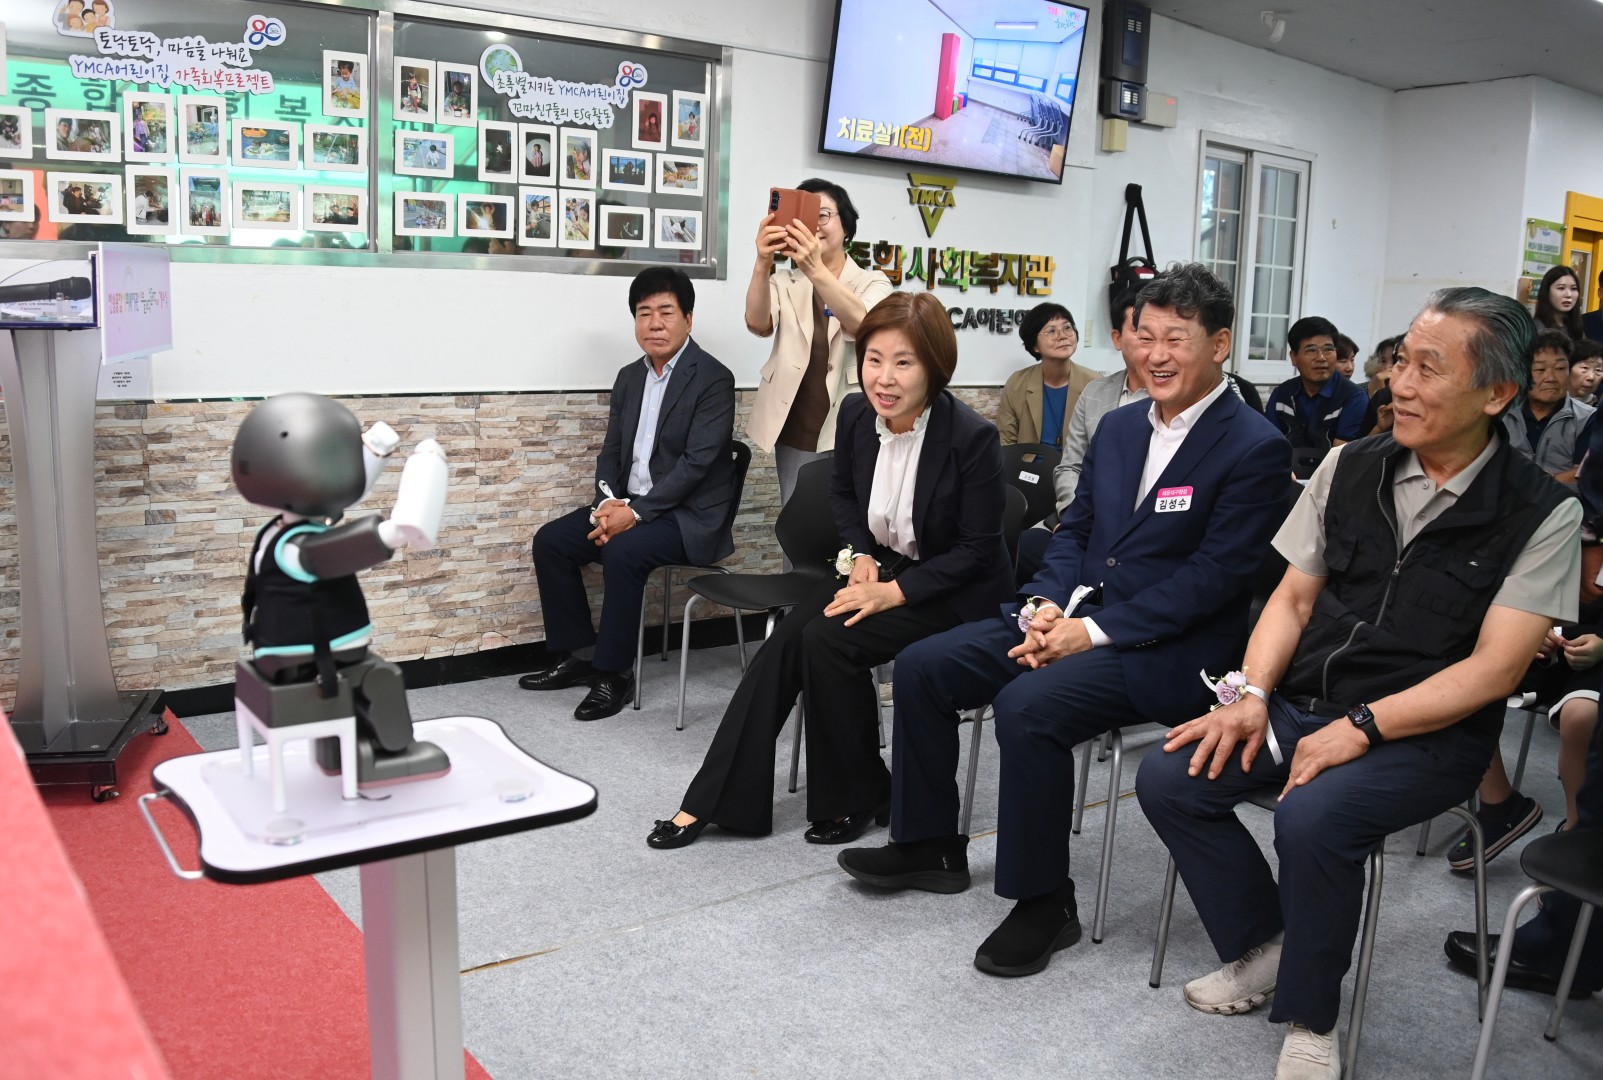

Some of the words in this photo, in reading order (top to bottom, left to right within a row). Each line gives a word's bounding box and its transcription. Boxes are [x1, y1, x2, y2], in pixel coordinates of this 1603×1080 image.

[99, 31, 161, 56] 토닥토닥,
[168, 40, 206, 60] 마음을
[211, 46, 249, 62] 나눠요
[74, 60, 170, 84] YMCA어린이집
[175, 66, 271, 90] 가족회복프로젝트
[558, 84, 626, 104] YMCA어린이집
[573, 106, 611, 125] ESG활동
[836, 116, 933, 152] 치료실1(전)
[907, 187, 956, 208] YMCA
[1159, 498, 1187, 510] 김성수
